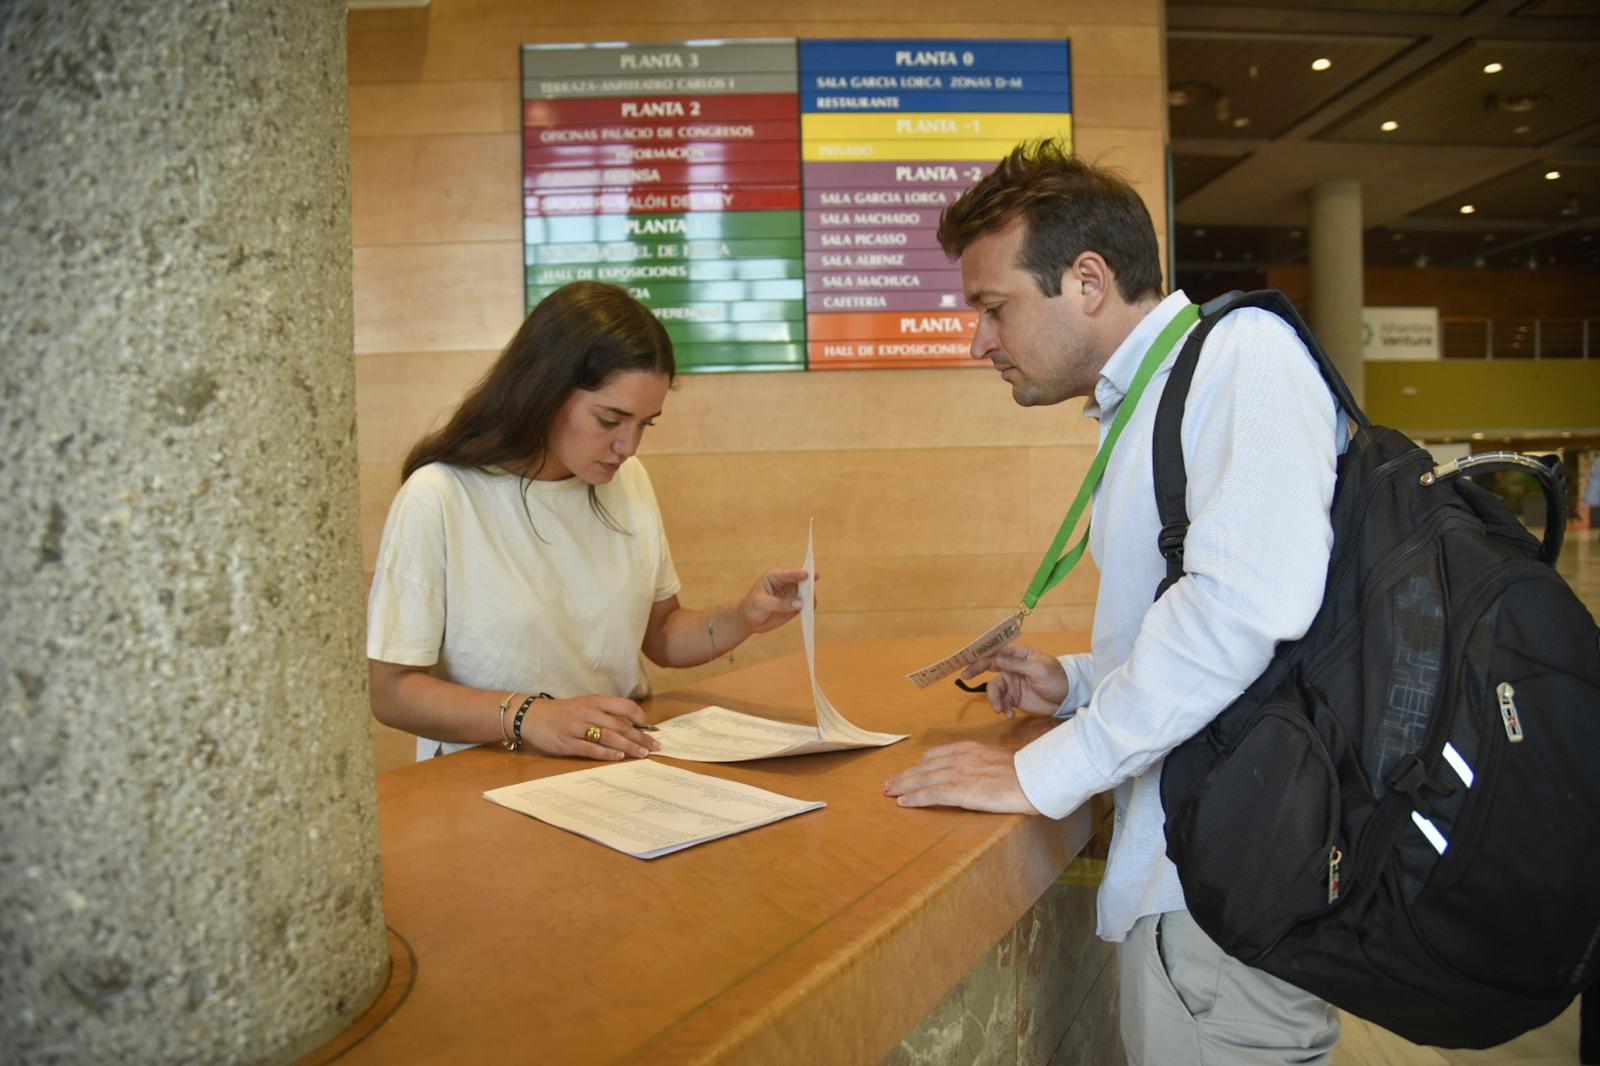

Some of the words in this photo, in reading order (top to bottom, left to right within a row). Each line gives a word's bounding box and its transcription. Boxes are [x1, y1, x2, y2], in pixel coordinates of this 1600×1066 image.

[620, 53, 682, 69] PLANTA
[689, 53, 700, 67] 3
[896, 51, 957, 66] PLANTA
[962, 51, 974, 66] 0
[677, 78, 726, 90] CARLOS
[816, 77, 846, 89] SALA
[900, 76, 942, 89] LORCA
[949, 76, 991, 88] ZONAS
[621, 102, 685, 117] PLANTA
[690, 101, 701, 115] 2
[817, 97, 900, 109] RESTAURANTE
[896, 119, 958, 133] PLANTA
[540, 128, 598, 142] OFICINAS
[601, 127, 652, 140] PALACIO
[657, 127, 674, 139] DE
[678, 125, 755, 138] CONGRESOS
[819, 145, 874, 158] PRIVADO
[896, 166, 958, 182] PLANTA
[963, 166, 982, 182] -2
[819, 193, 851, 205] SALA
[854, 192, 901, 204] GARCIA
[904, 192, 946, 204] LORCA
[820, 213, 850, 225] SALA
[854, 213, 920, 225] MACHADO
[625, 218, 687, 234] PLANTA
[820, 234, 851, 246] SALA
[855, 233, 907, 245] PICASSO
[657, 244, 679, 257] DE
[821, 254, 852, 266] SALA
[855, 254, 905, 266] ALBENIZ
[543, 267, 573, 281] HALL
[577, 266, 593, 279] DE
[598, 264, 687, 279] EXPOSICIONES
[822, 275, 853, 287] SALA
[856, 275, 920, 287] MACHUCA
[823, 296, 887, 309] CAFETERIA
[900, 318, 963, 333] PLANTA
[1381, 335, 1434, 347] venture
[824, 344, 854, 357] HALL
[858, 344, 874, 357] DE
